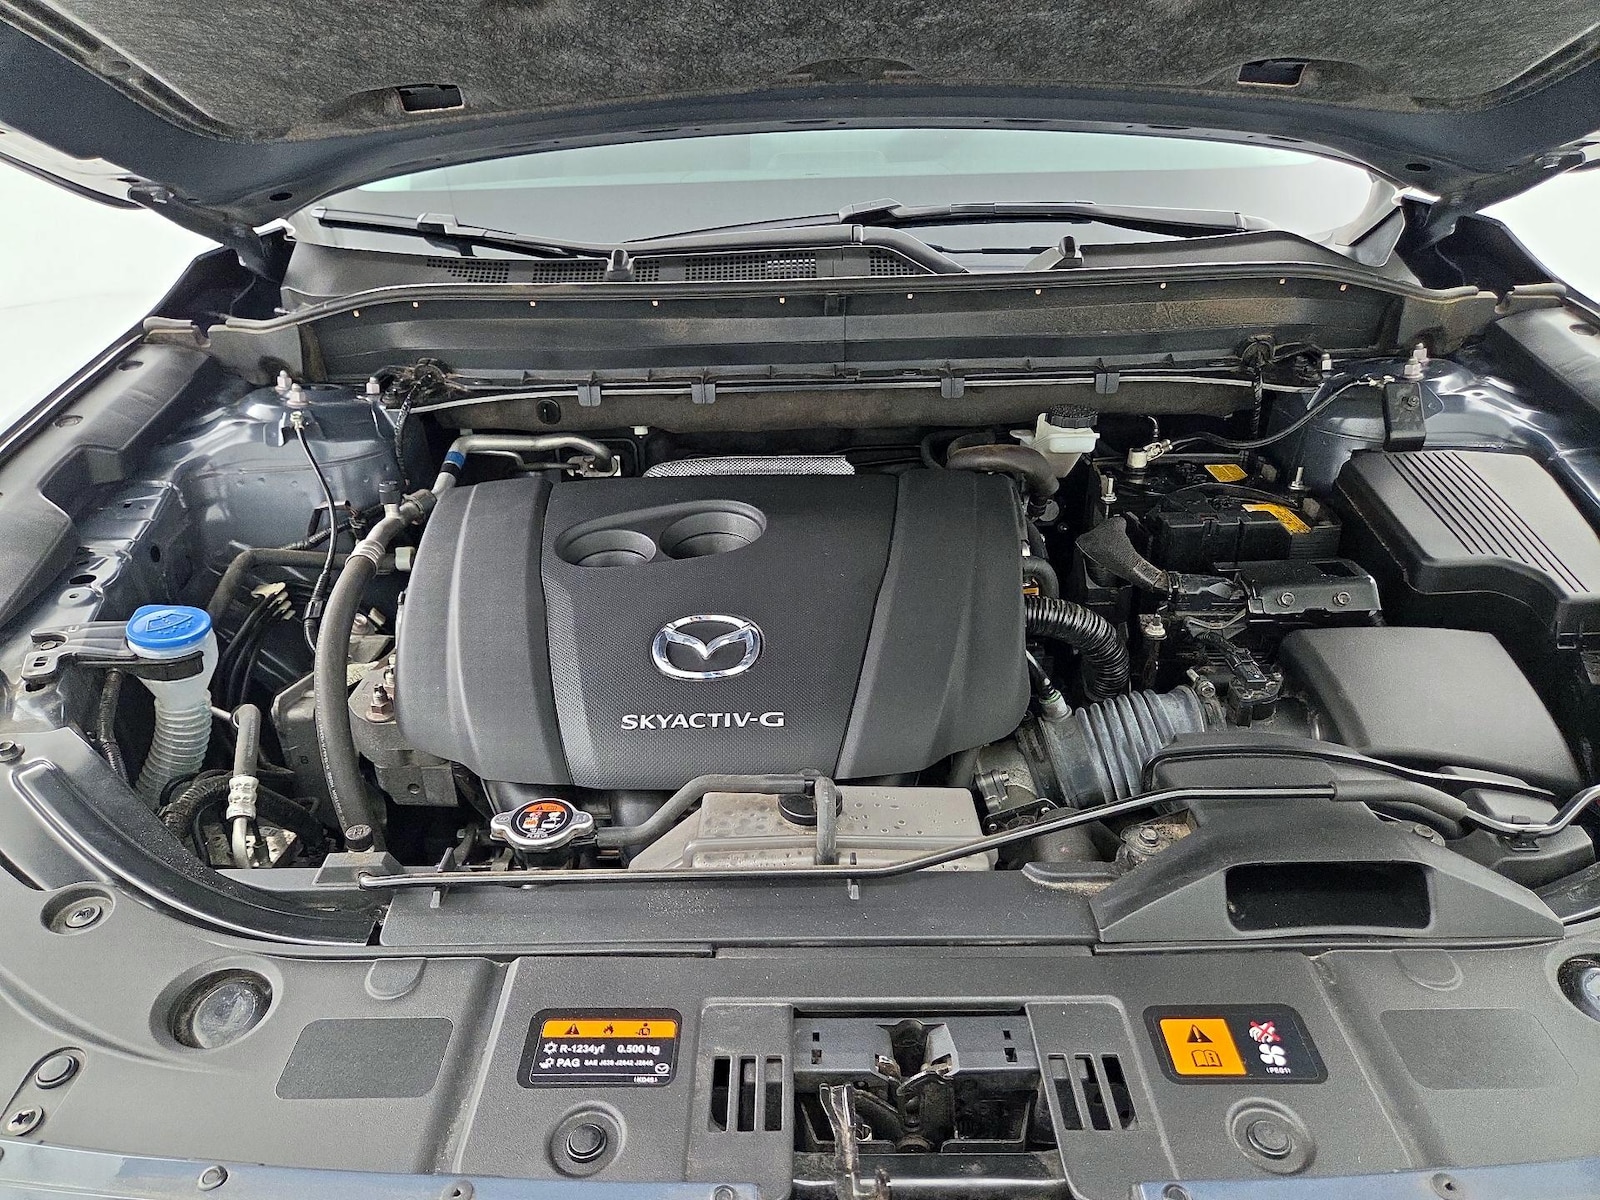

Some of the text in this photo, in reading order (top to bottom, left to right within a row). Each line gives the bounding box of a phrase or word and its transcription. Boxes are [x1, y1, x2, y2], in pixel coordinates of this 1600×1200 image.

[620, 711, 785, 730] SKYACTIV-G
[560, 1044, 660, 1055] R-1234yf 0.500 kg
[556, 1058, 580, 1068] PAG
